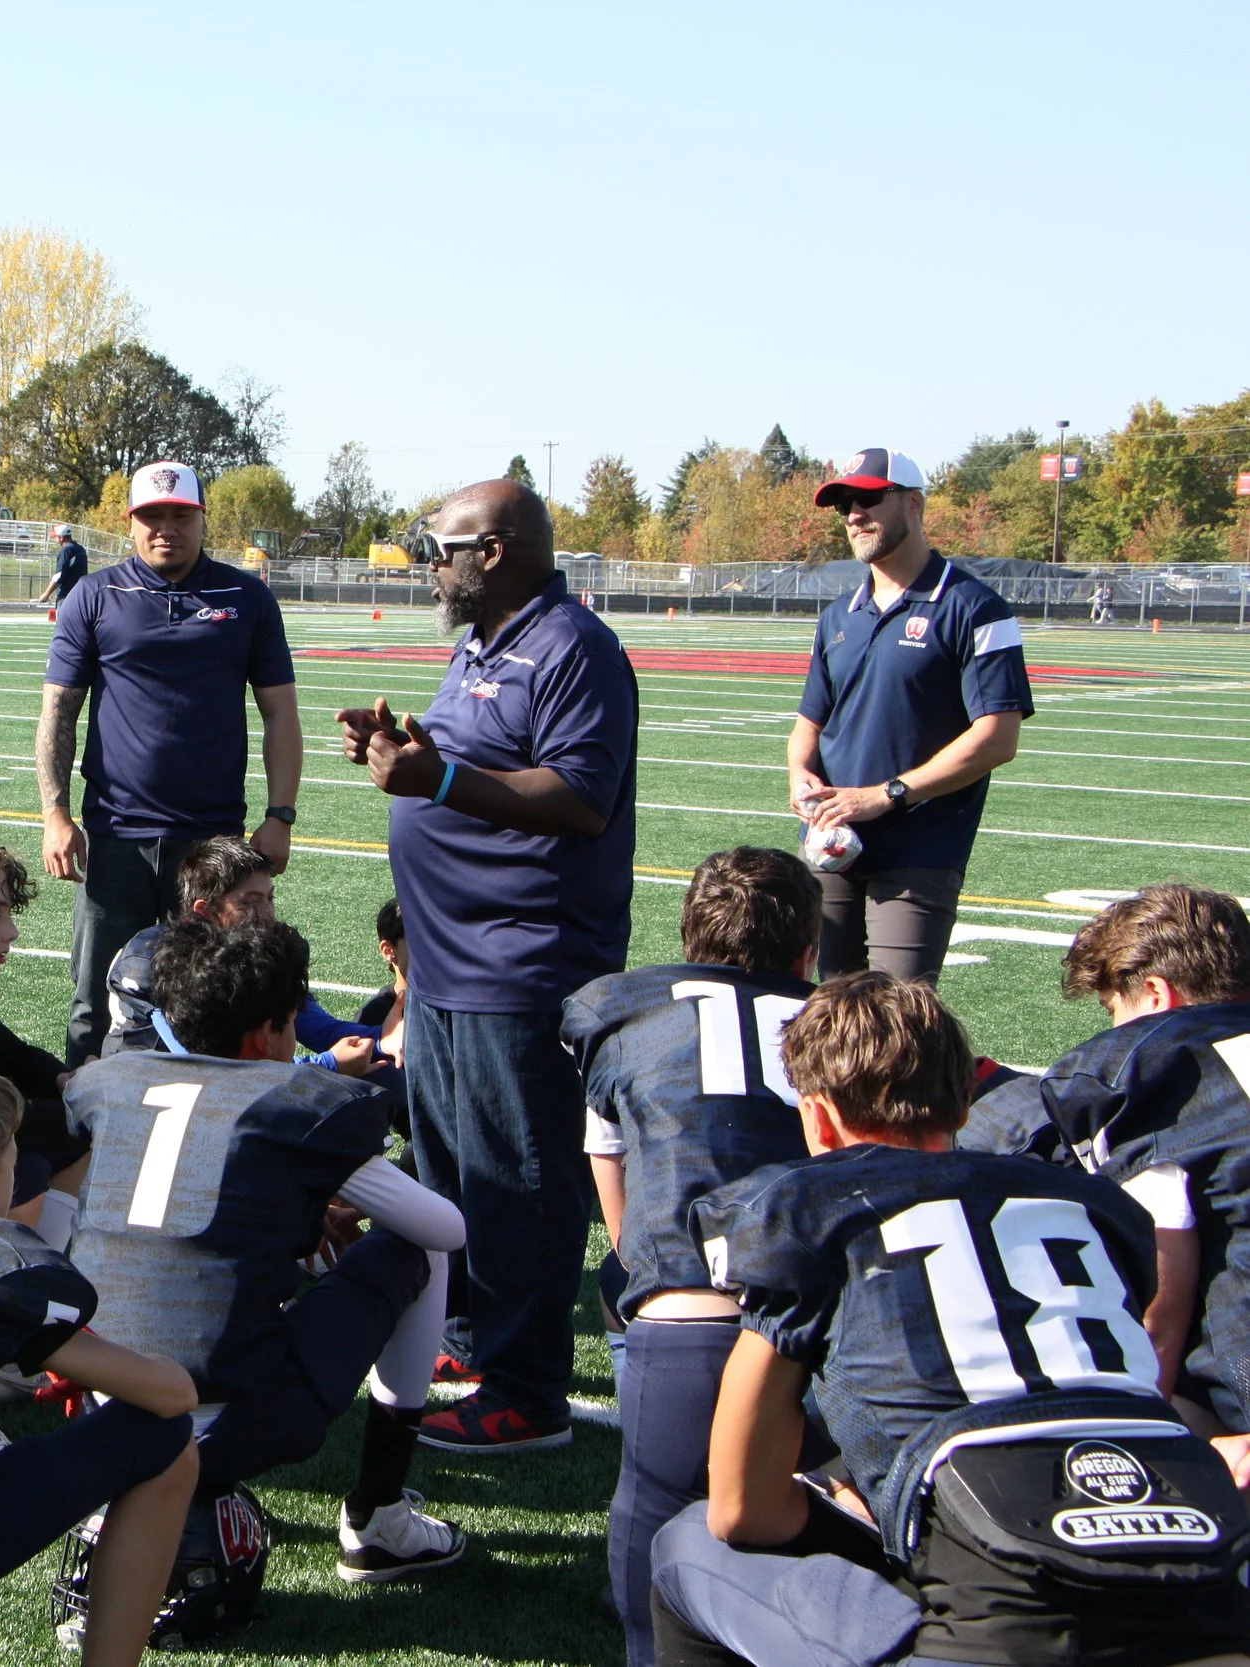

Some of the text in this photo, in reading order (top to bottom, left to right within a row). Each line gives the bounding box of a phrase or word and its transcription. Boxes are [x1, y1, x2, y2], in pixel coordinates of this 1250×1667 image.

[127, 1083, 202, 1228] 1
[880, 1198, 1163, 1404] 18
[1071, 1458, 1138, 1476] OREGON
[1085, 1475, 1138, 1488] ALL STATE
[1101, 1486, 1133, 1497] GAME
[1067, 1514, 1206, 1538] BATTLE
